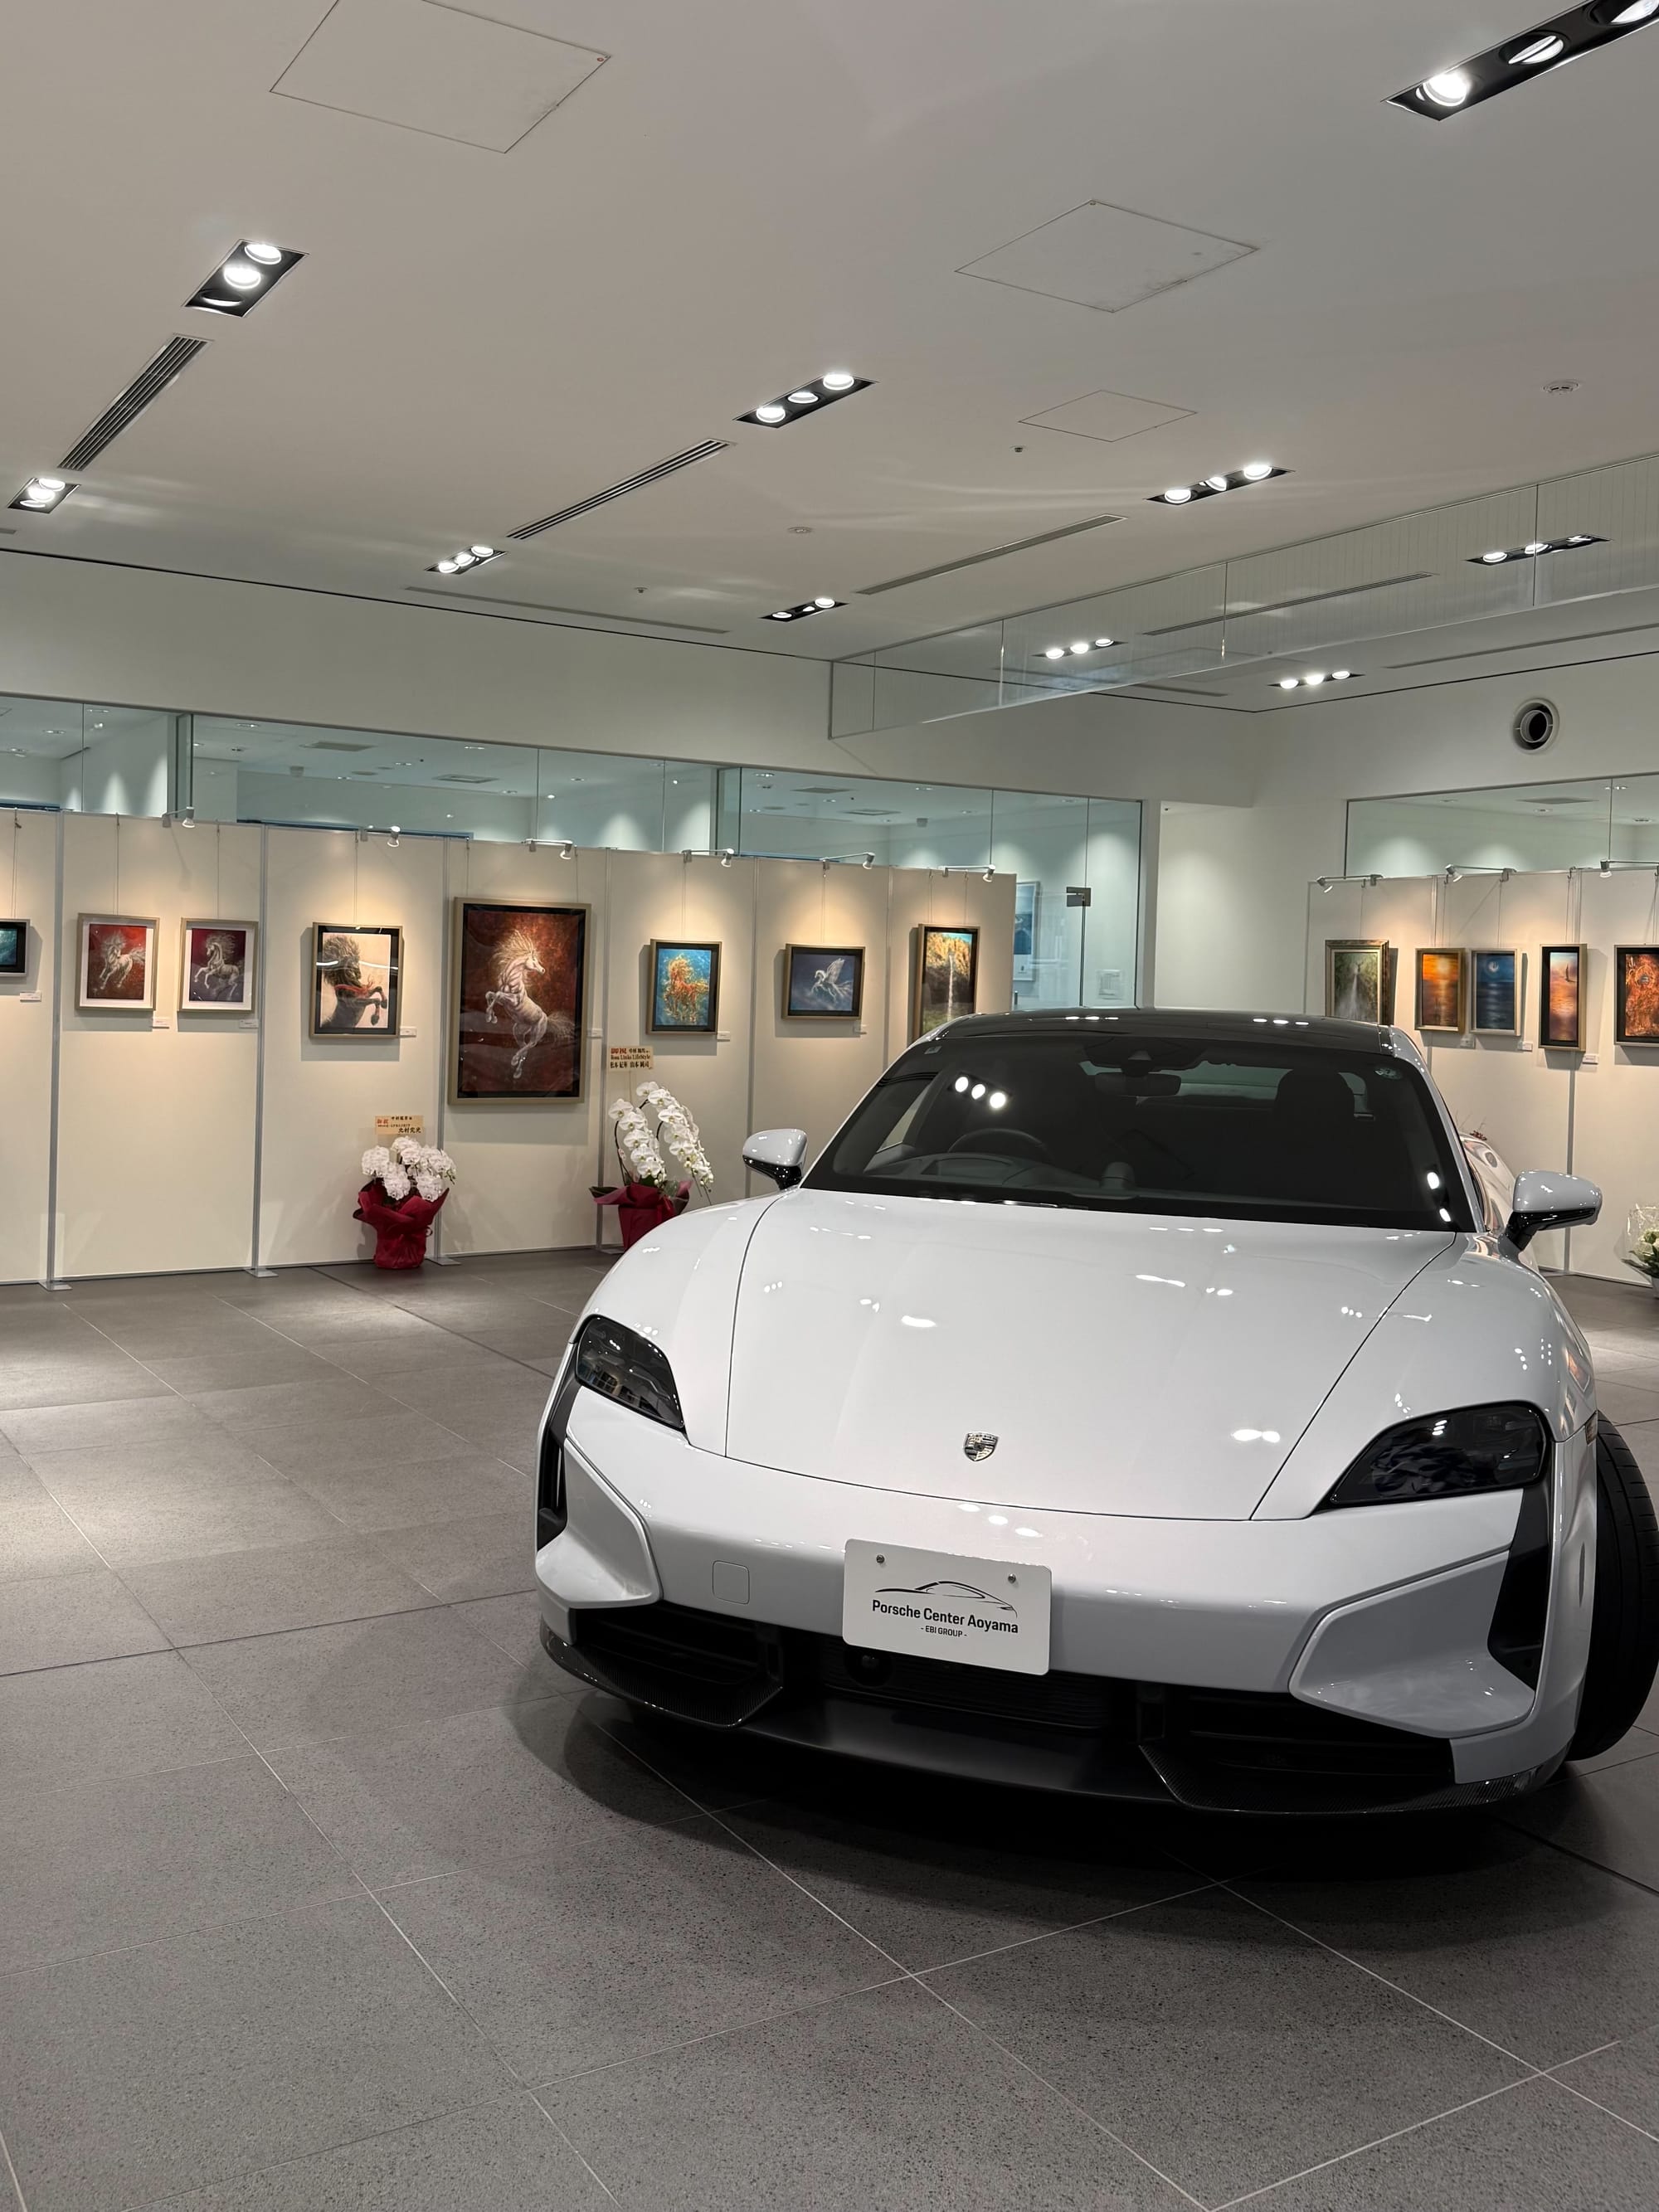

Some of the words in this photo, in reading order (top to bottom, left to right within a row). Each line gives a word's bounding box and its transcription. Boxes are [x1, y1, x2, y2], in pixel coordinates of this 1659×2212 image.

[872, 1599, 921, 1618] Porsche
[923, 1607, 965, 1626] Center
[967, 1614, 1019, 1633] Aoyama
[925, 1625, 937, 1634] EBI
[937, 1626, 963, 1637] GROUP
